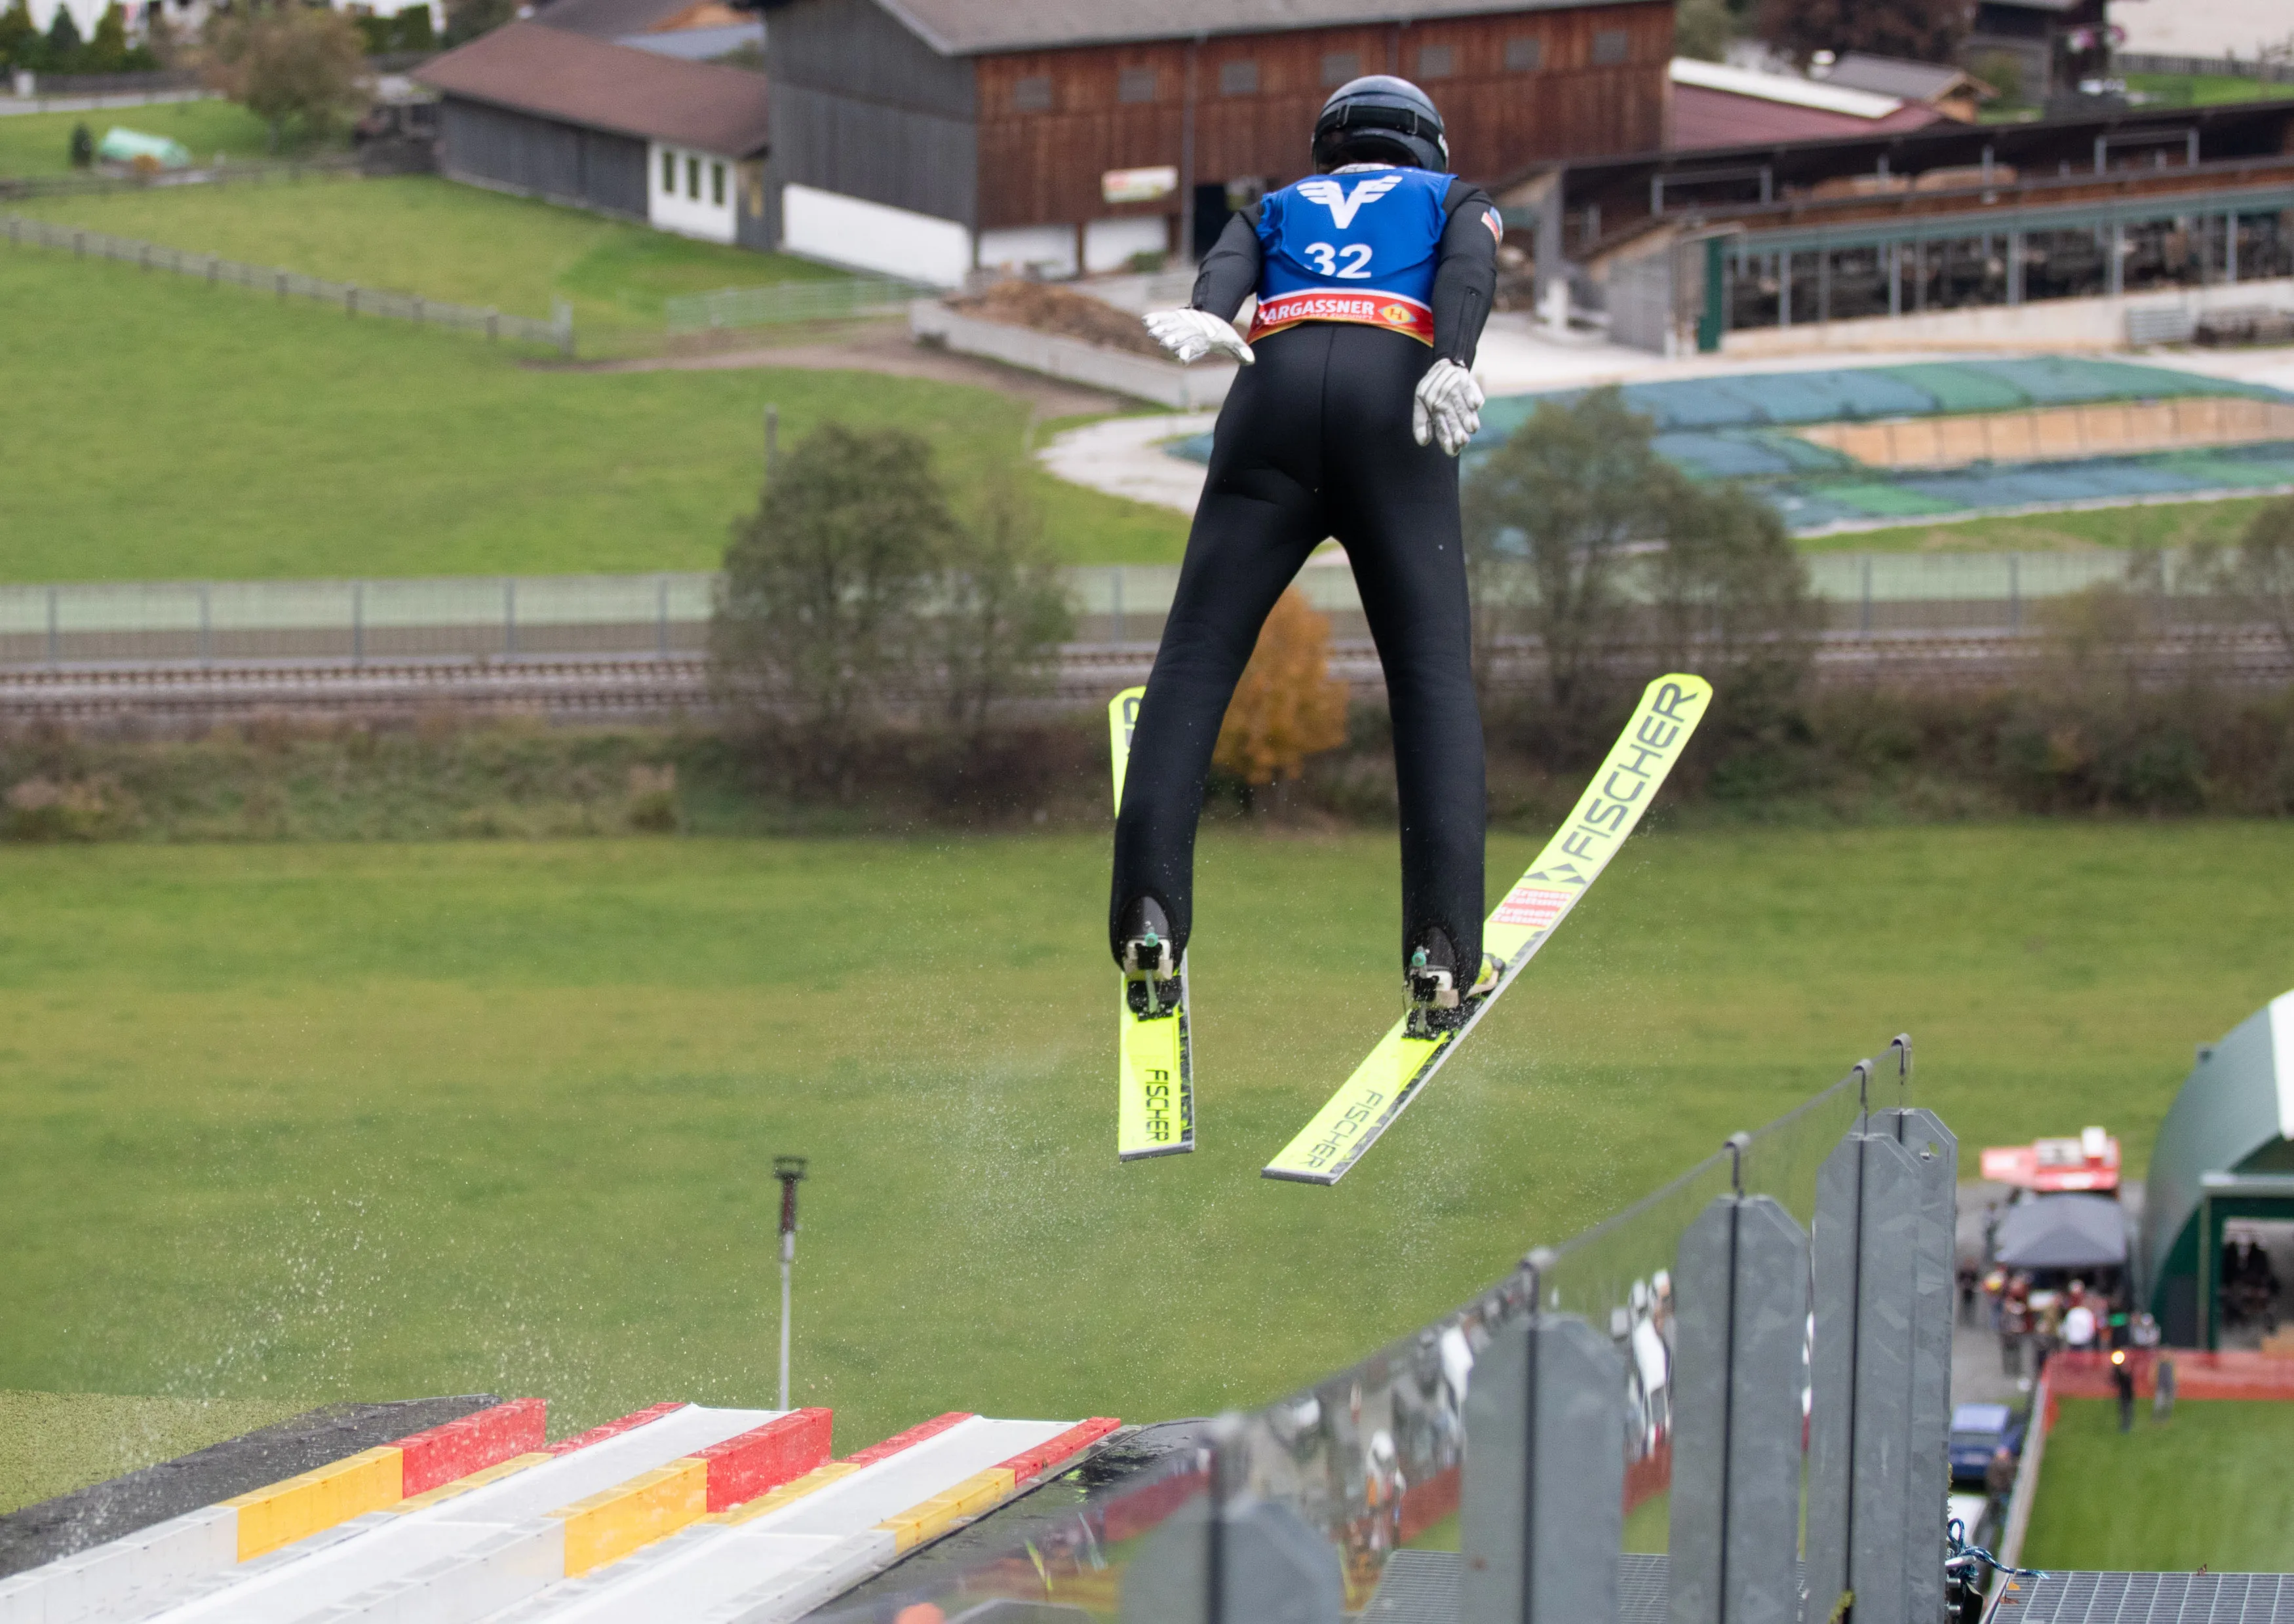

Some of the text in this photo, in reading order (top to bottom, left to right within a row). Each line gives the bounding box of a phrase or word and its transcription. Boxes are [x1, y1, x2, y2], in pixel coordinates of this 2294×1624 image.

[1303, 241, 1373, 279] 32
[1561, 682, 1699, 862] FISCHER
[1146, 1069, 1169, 1142] FISCHER
[1298, 1089, 1384, 1168] FISCHER
